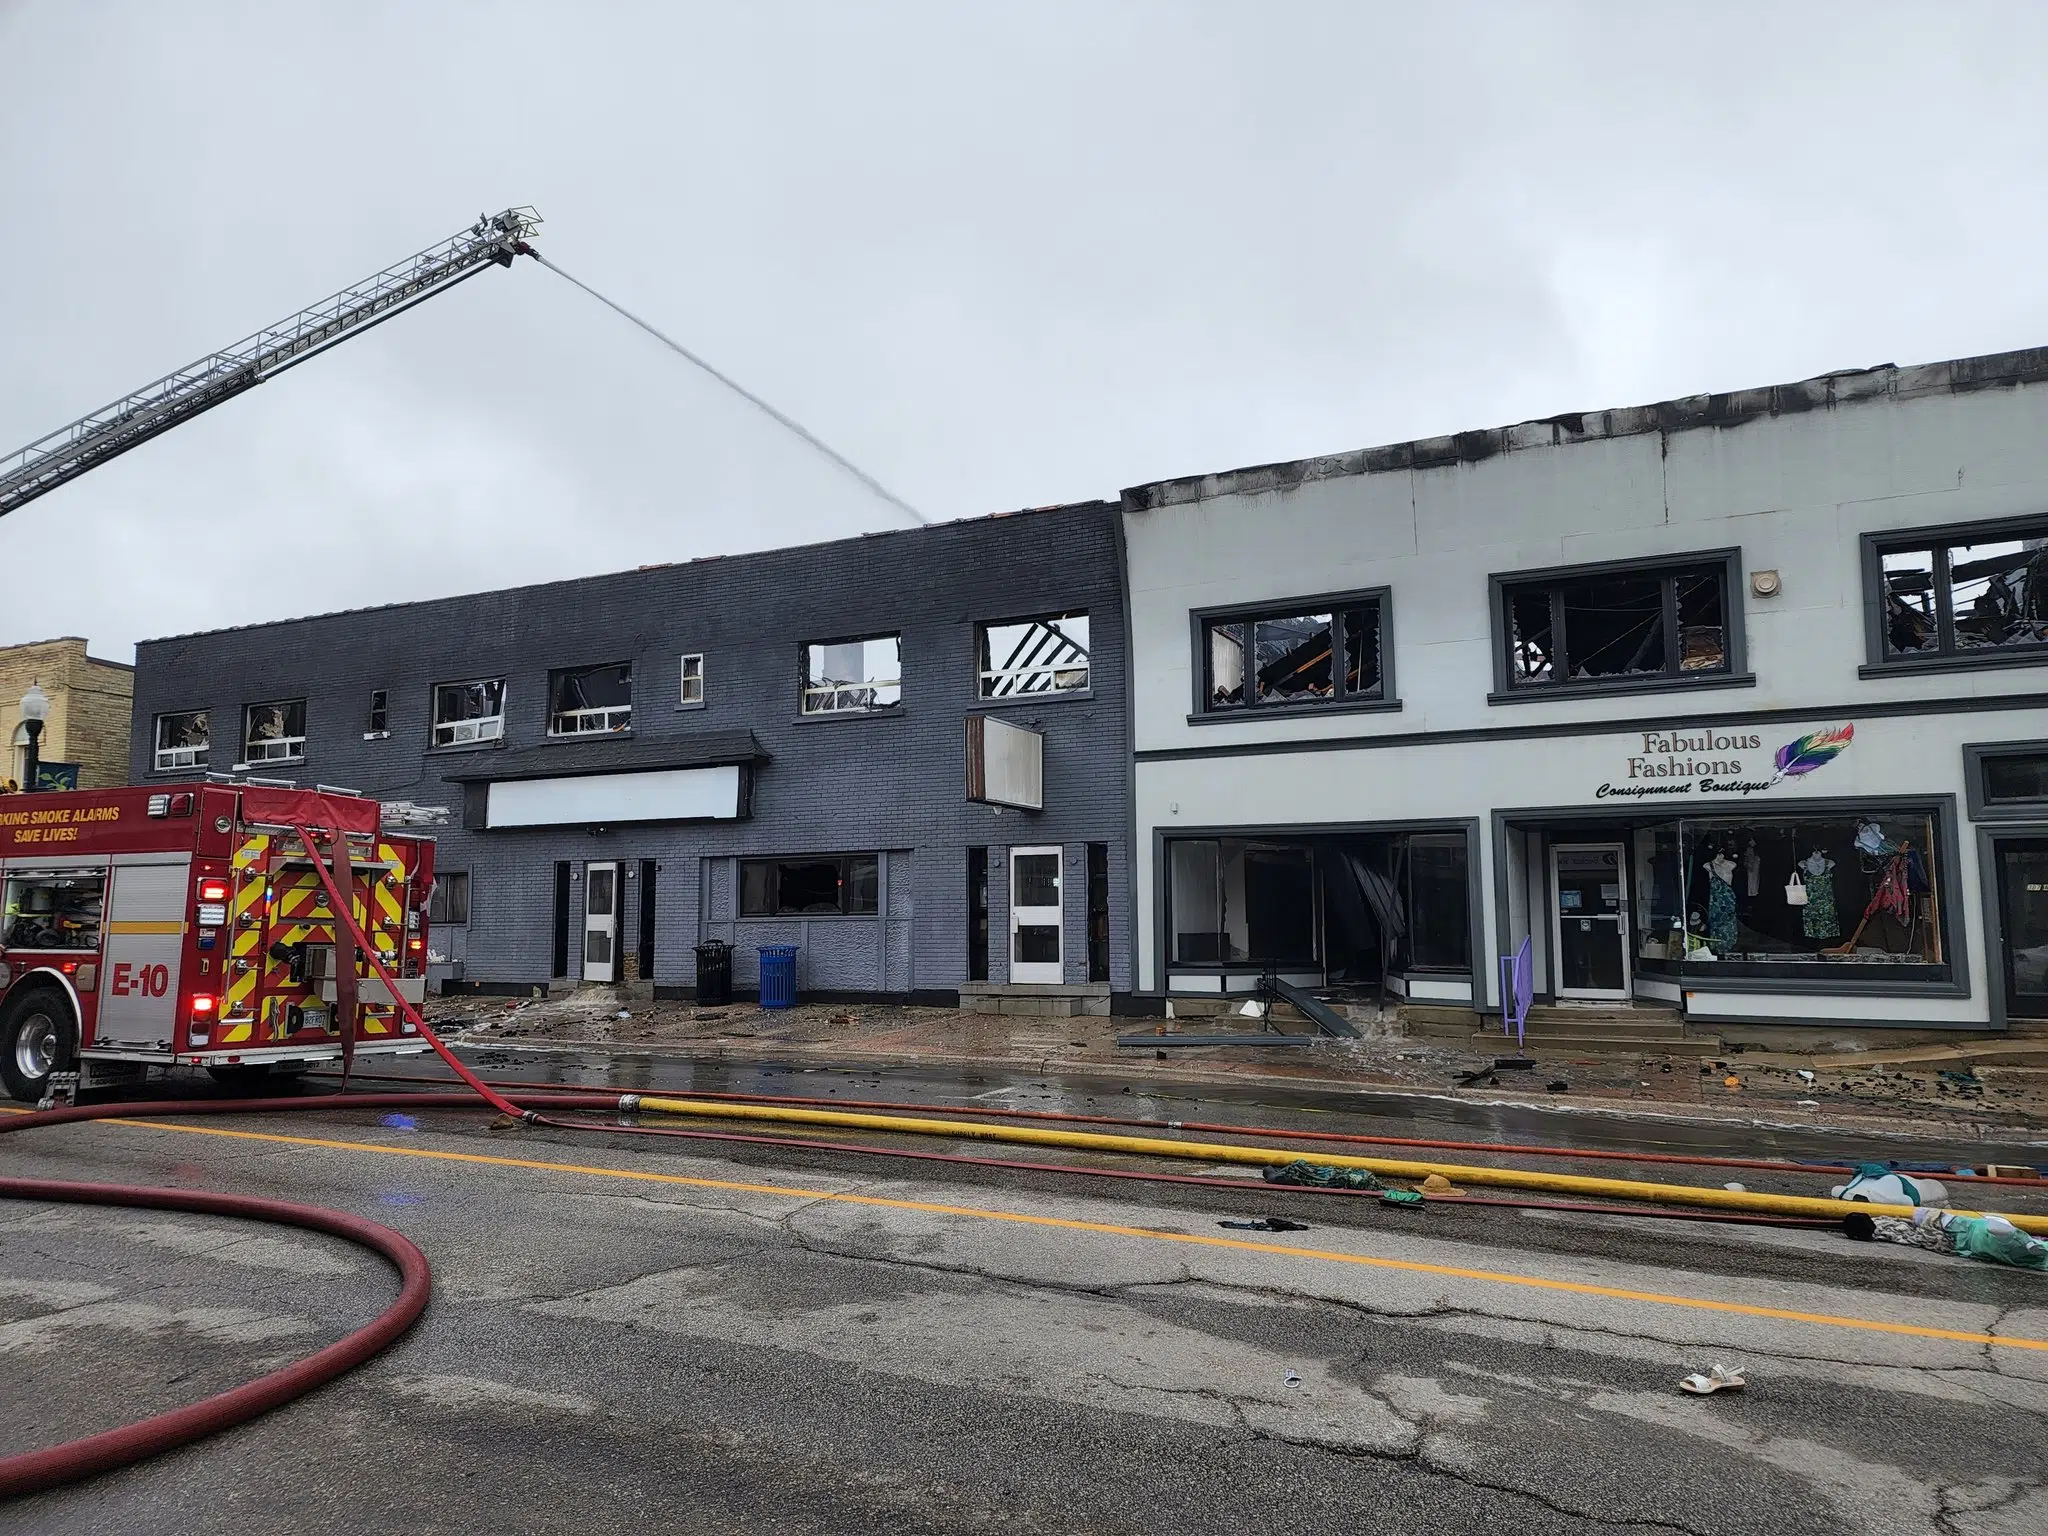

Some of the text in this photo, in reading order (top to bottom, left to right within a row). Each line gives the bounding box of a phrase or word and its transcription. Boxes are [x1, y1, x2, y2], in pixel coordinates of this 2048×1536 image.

[1641, 729, 1761, 754] Fabulous
[1627, 756, 1742, 779] Fashions
[1595, 779, 1770, 799] Consignment Boutique
[30, 809, 71, 825] SMOKE
[72, 806, 120, 823] ALARMS
[14, 827, 79, 843] SAVE LIVES!
[112, 963, 169, 998] E-10
